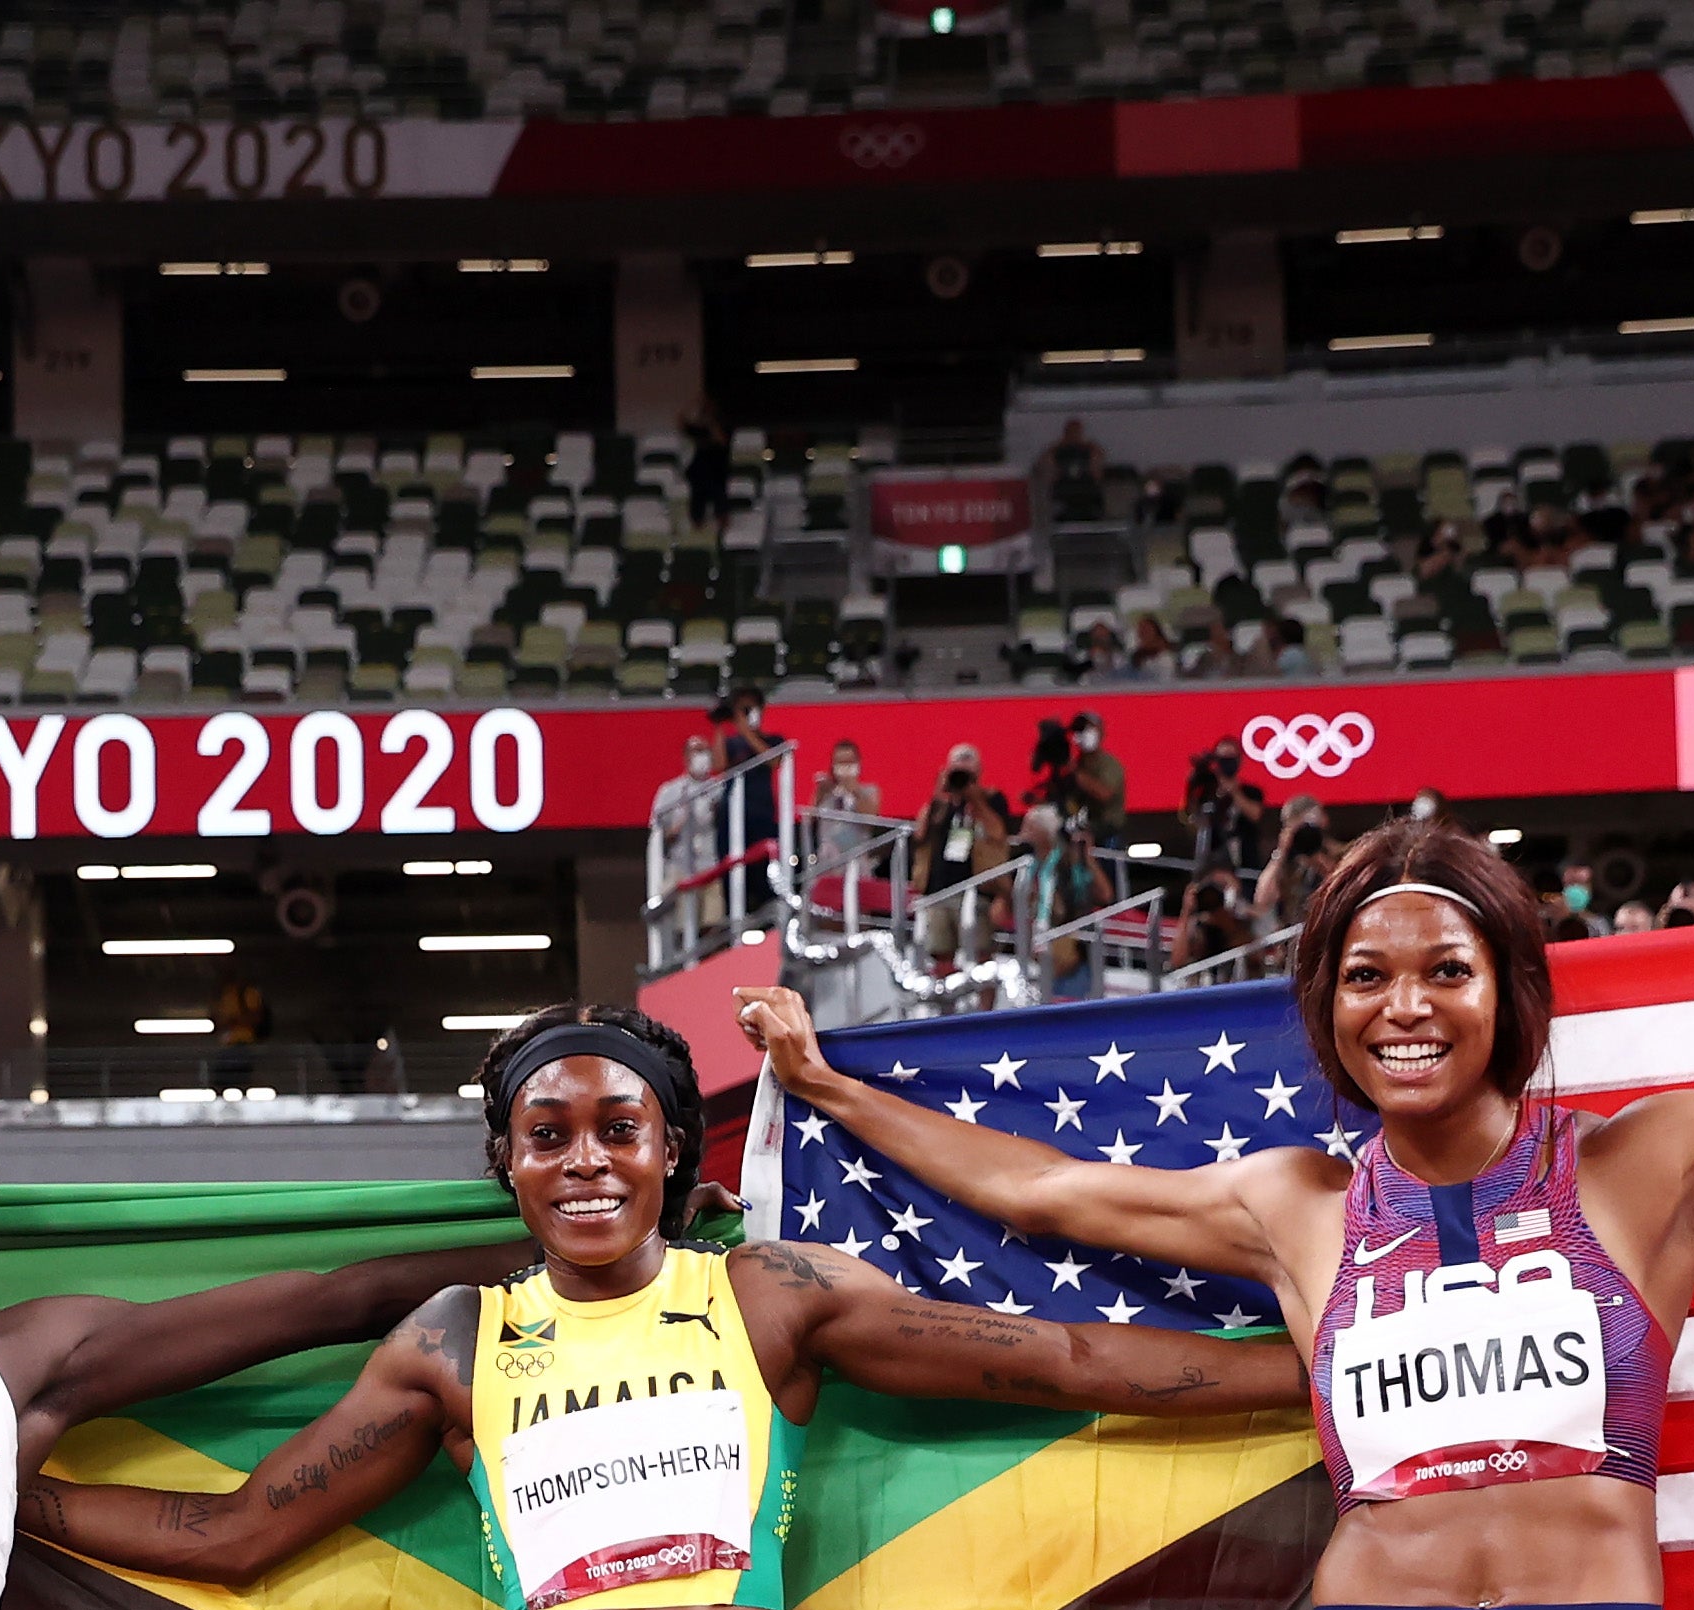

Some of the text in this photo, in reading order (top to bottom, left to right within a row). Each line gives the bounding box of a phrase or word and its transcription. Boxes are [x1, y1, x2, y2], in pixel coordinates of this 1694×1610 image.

[167, 120, 387, 198] 2020
[196, 708, 545, 838] 2020
[1344, 1331, 1590, 1419] THOMAS
[267, 1484, 296, 1511] One
[328, 1443, 365, 1471] One
[512, 1443, 741, 1514] THOMPSON-HERAH
[1414, 1459, 1486, 1481] TOKYO 2020
[586, 1555, 656, 1580] TOKYO 2020
